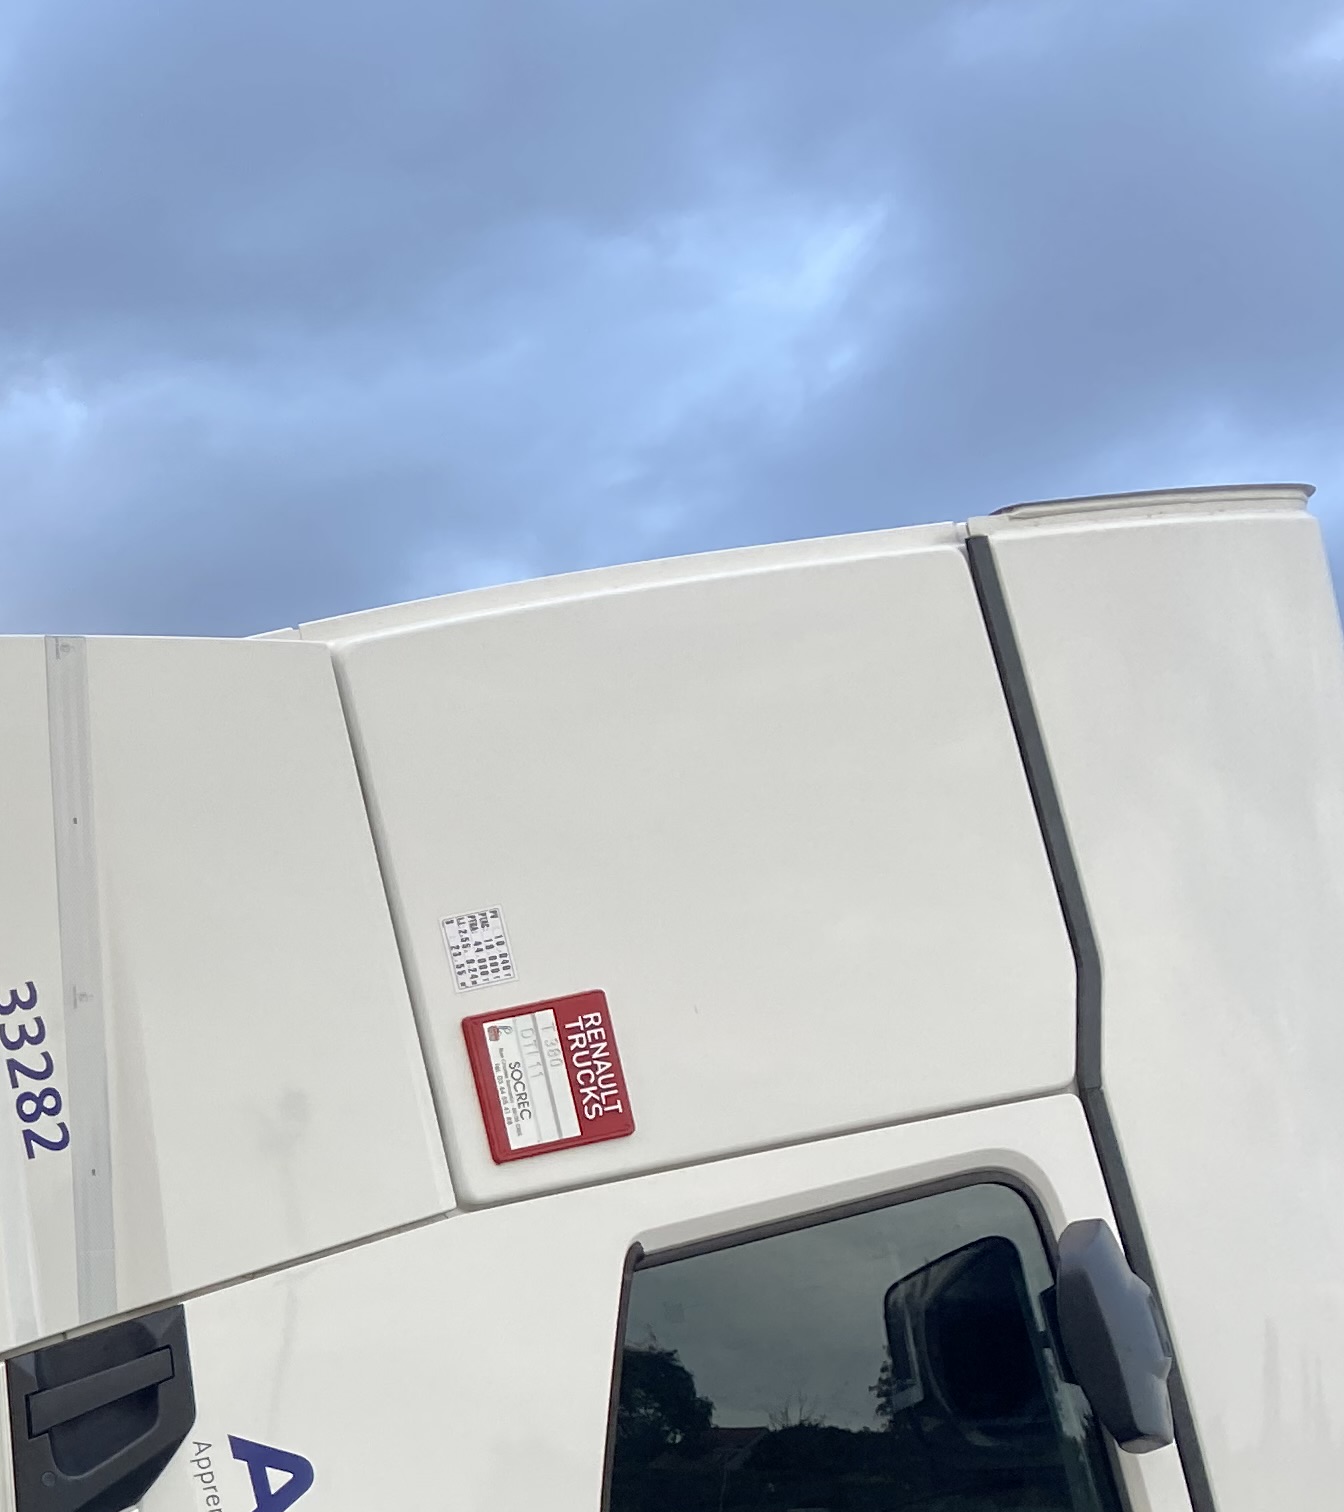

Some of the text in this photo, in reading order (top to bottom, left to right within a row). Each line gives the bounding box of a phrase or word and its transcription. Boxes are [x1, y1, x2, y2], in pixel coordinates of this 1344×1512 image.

[509, 1061, 531, 1120] SOCREC
[565, 1016, 603, 1120] TRUCKS
[583, 1012, 623, 1113] RENAULT
